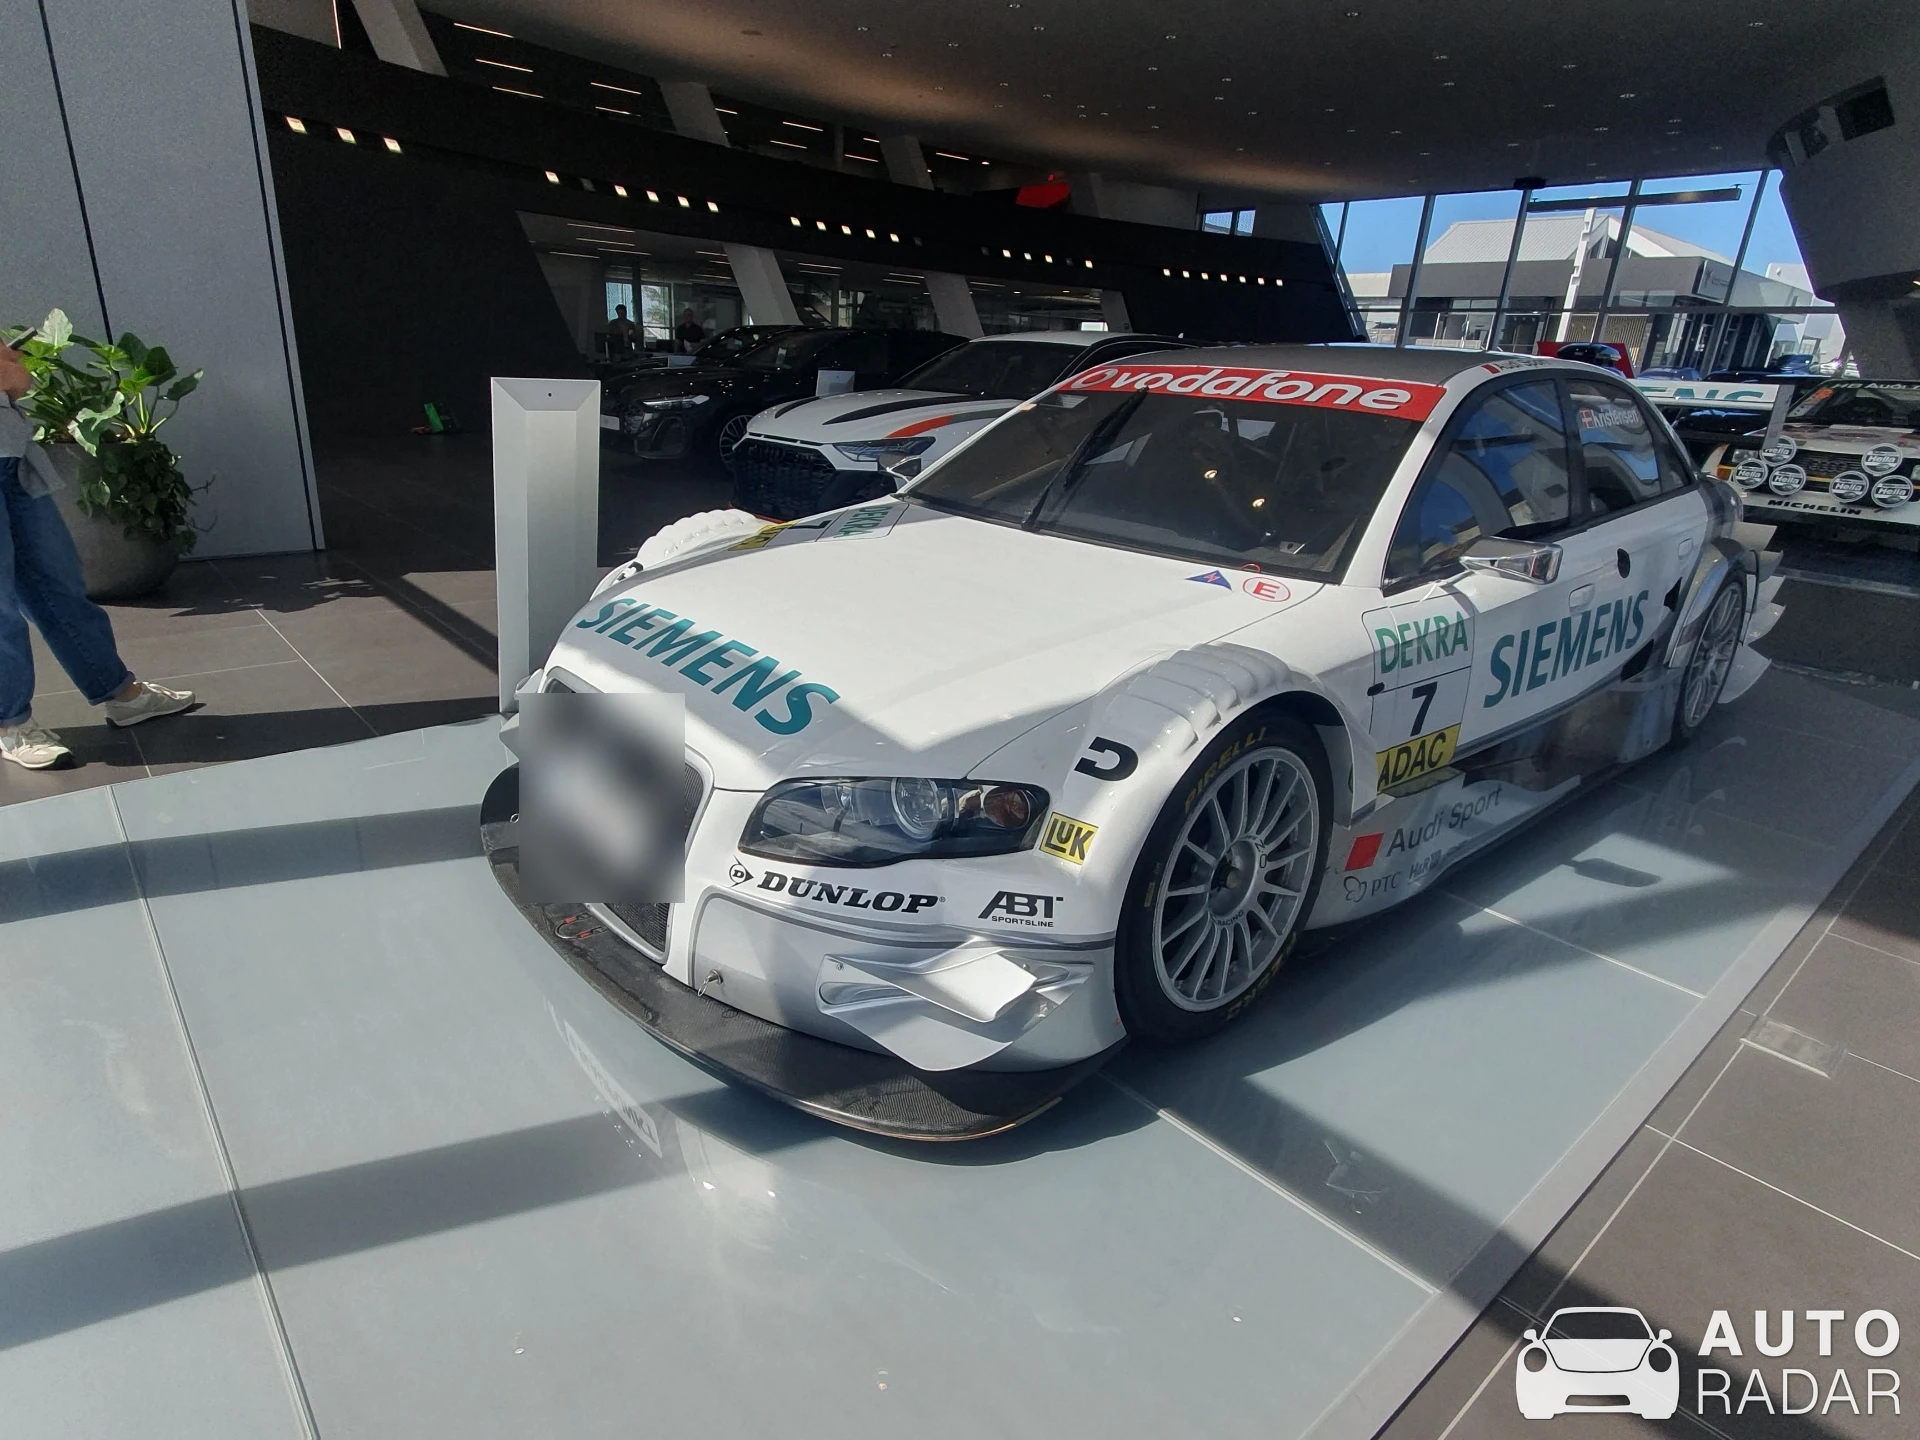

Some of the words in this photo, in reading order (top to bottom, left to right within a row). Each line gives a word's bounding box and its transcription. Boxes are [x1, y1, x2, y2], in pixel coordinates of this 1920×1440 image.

[1111, 368, 1412, 410] vodafone
[1867, 455, 1896, 463] Hella
[1737, 470, 1762, 478] Hella
[1774, 475, 1799, 484] Hella
[1835, 483, 1862, 491] Hella
[1877, 487, 1907, 496] Hella
[1767, 499, 1862, 516] MICHELIN
[1253, 581, 1280, 599] E
[1375, 610, 1469, 674] DEKRA
[1483, 589, 1649, 709] SIEMENS
[575, 597, 841, 736] SIEMENS
[1410, 681, 1438, 737] 7
[1377, 731, 1447, 792] ADAC
[1386, 811, 1444, 857] Audi
[1448, 784, 1502, 830] Sport
[1371, 871, 1402, 897] PTC
[978, 890, 1064, 919] ABT
[991, 915, 1054, 928] SPORTSLINE
